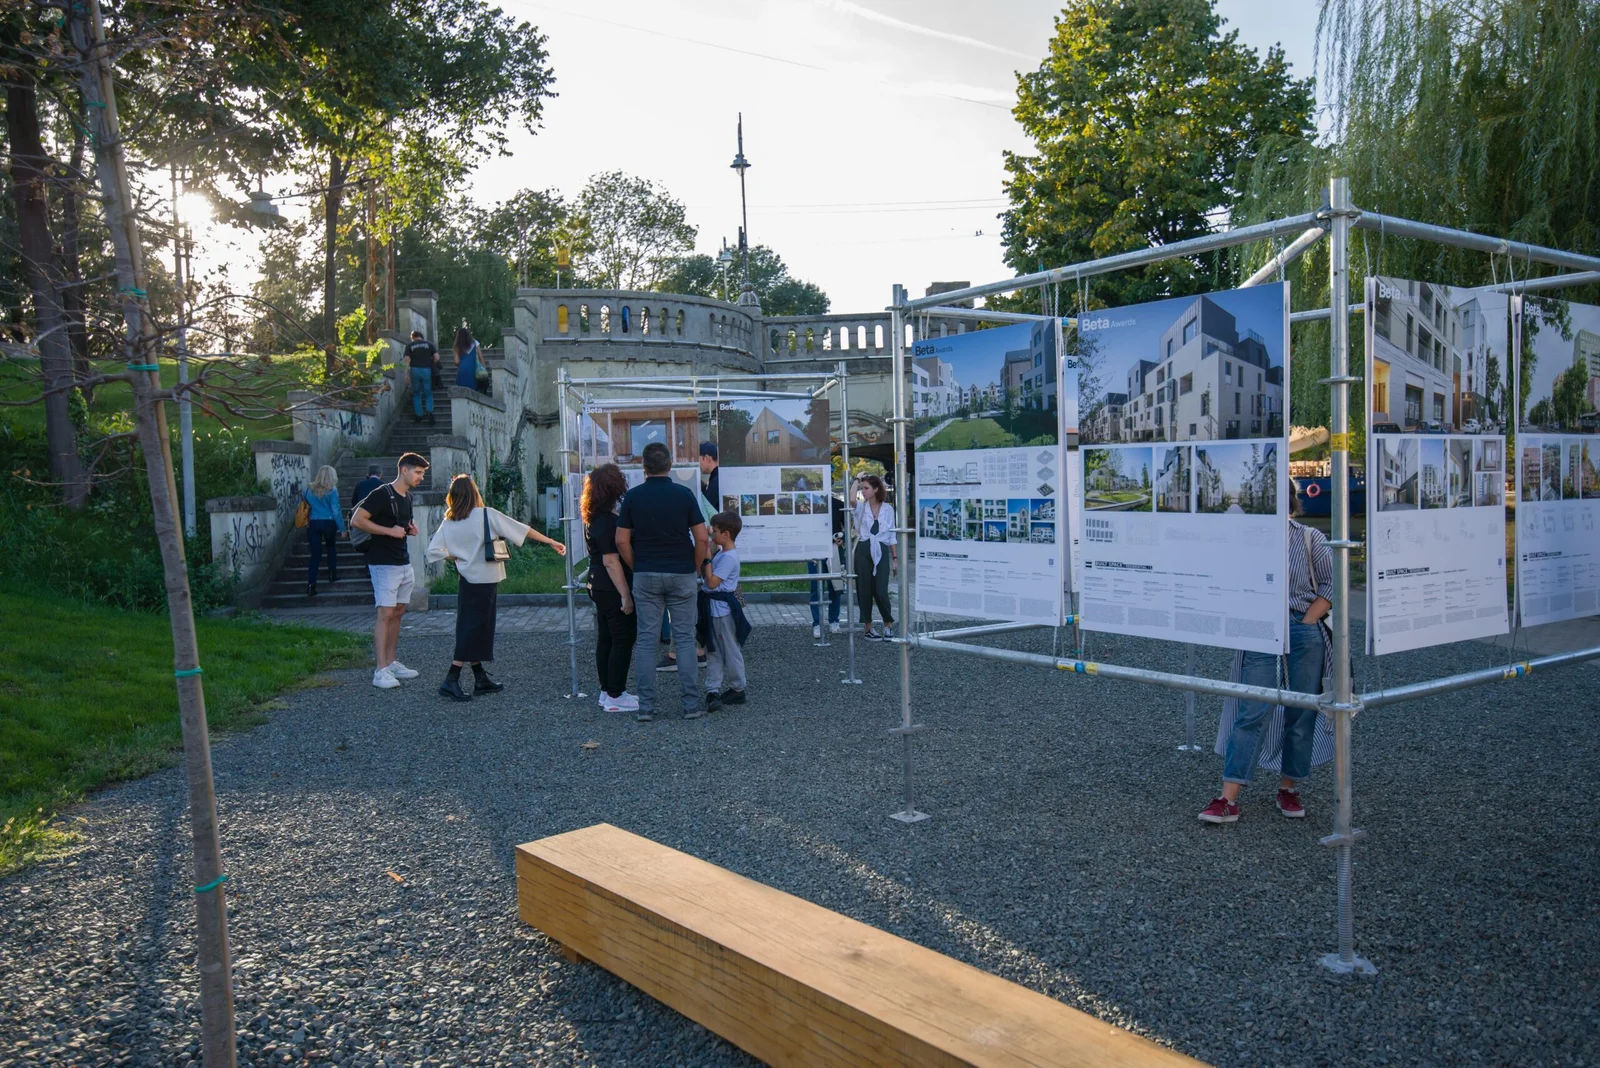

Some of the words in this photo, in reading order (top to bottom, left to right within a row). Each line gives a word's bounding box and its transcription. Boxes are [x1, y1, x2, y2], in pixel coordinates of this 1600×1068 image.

[1379, 283, 1400, 300] Beta
[1525, 301, 1541, 317] Beta
[1082, 317, 1109, 331] Beta
[1110, 318, 1136, 328] Awards
[915, 345, 934, 356] Beta
